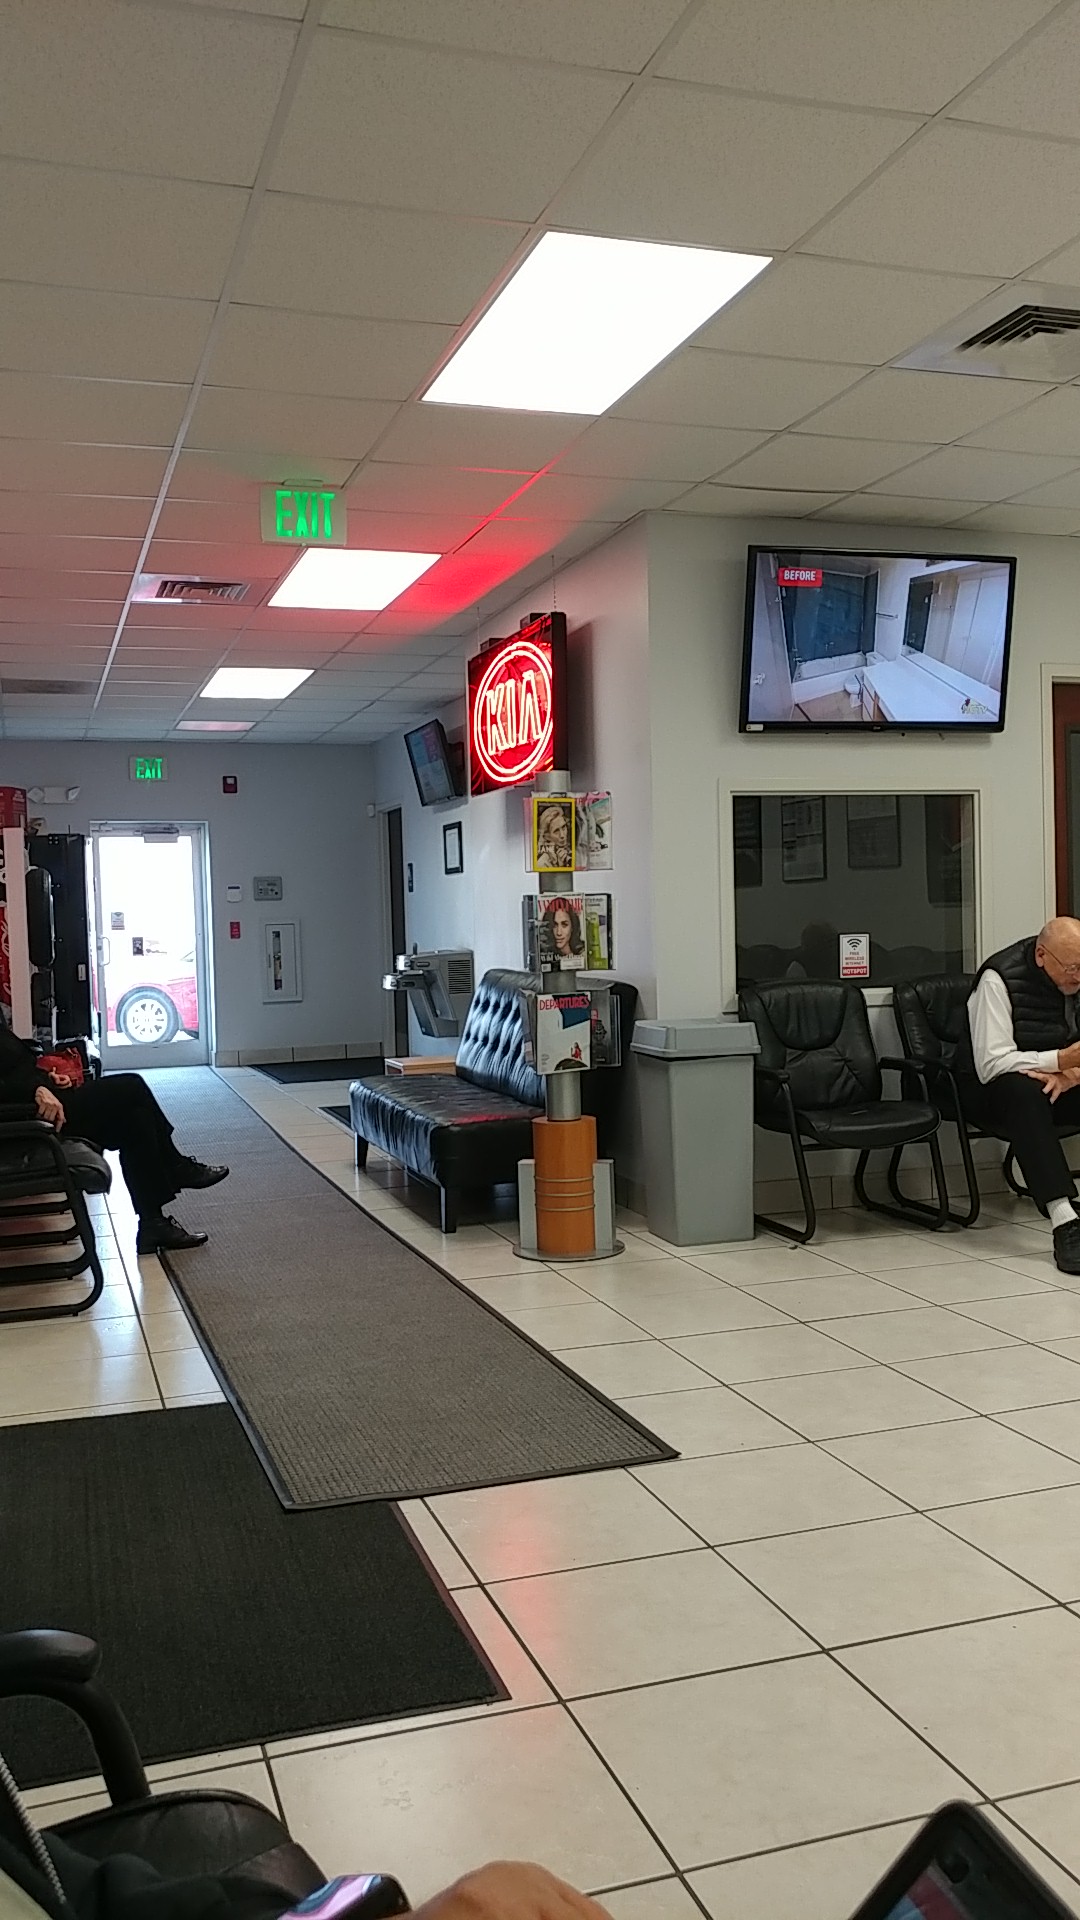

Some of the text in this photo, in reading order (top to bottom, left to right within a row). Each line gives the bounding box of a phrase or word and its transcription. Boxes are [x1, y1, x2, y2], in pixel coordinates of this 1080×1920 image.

[275, 490, 335, 539] EXIT
[783, 569, 816, 582] BEFORE
[485, 669, 543, 757] KIA
[135, 757, 163, 779] EXIT
[539, 995, 590, 1011] DEPARTURES
